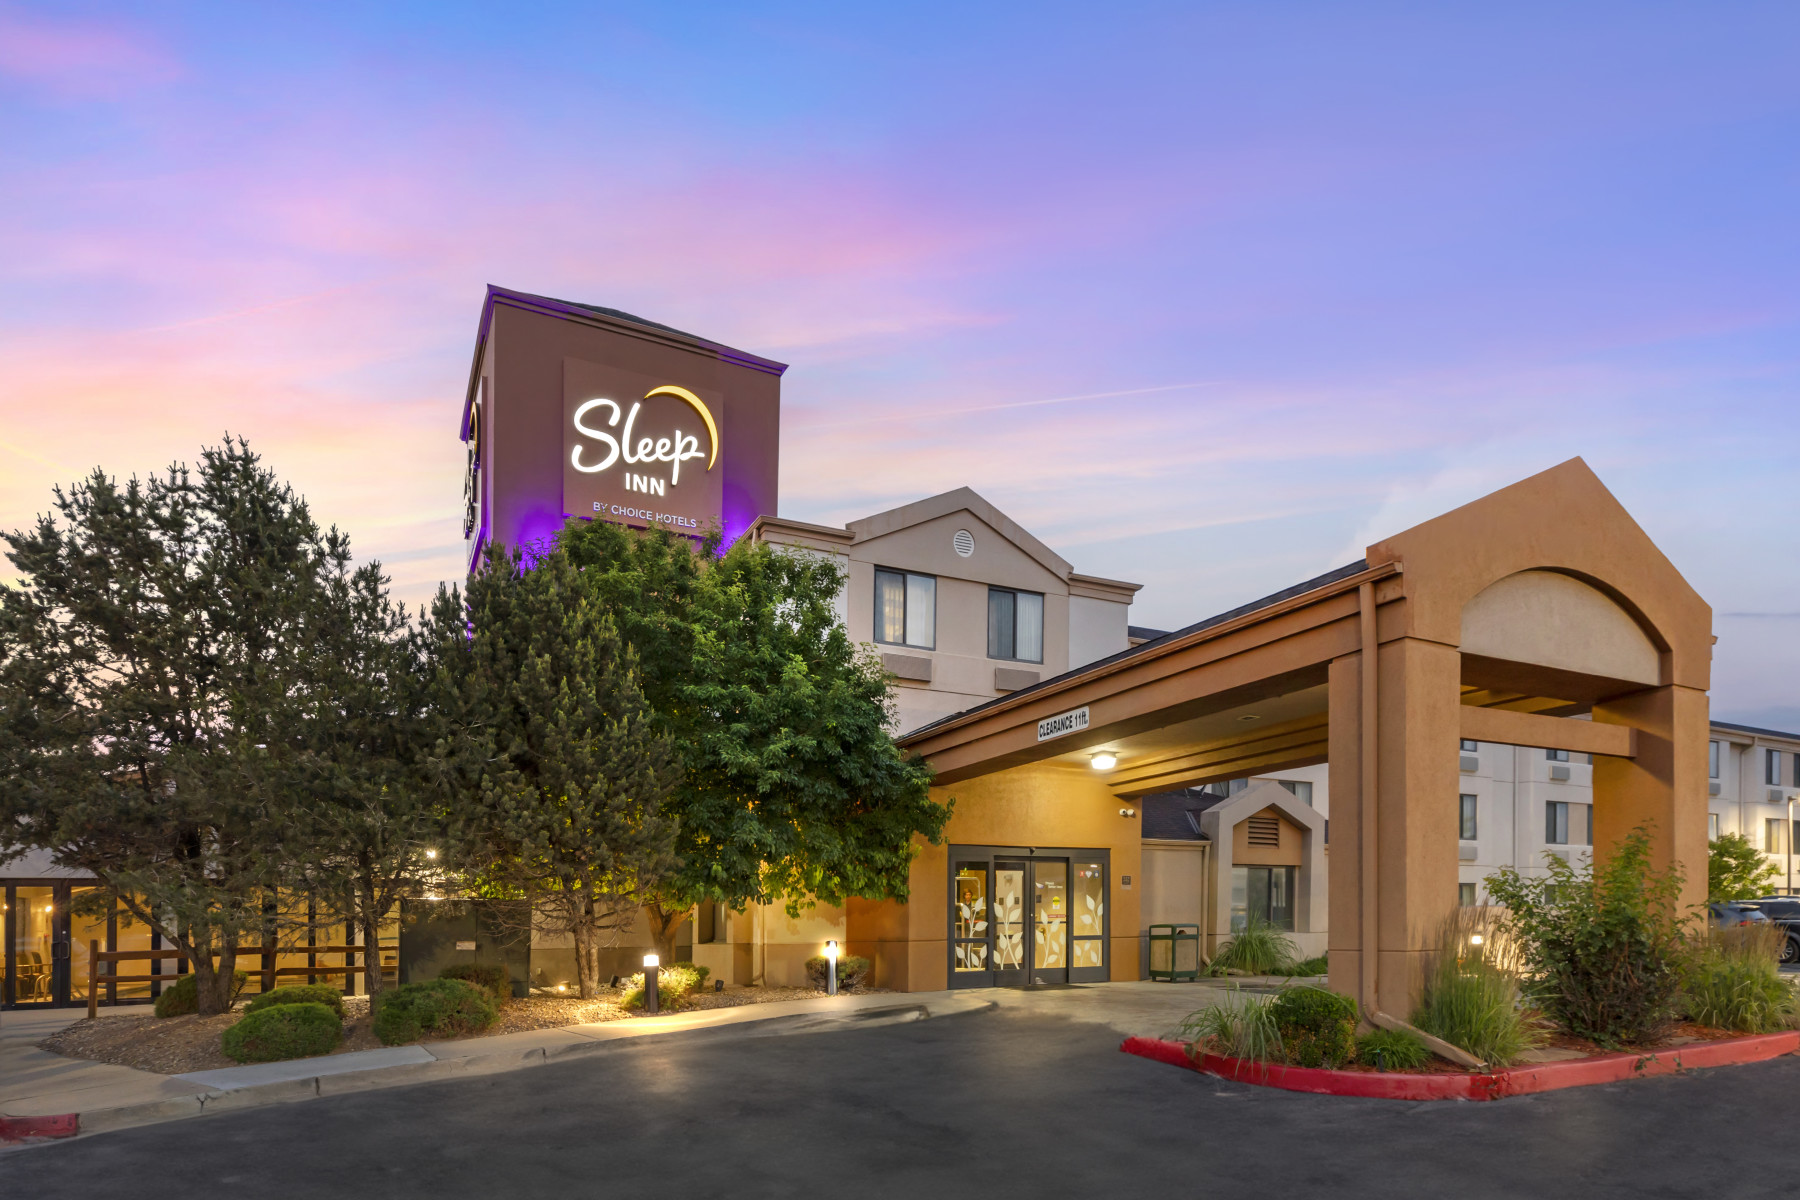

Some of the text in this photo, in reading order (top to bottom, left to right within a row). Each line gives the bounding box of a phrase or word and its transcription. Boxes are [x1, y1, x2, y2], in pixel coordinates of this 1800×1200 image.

[571, 398, 705, 486] Sleep
[625, 472, 664, 496] INN
[593, 502, 697, 528] BY CHOICE HOTELS
[1039, 715, 1073, 738] CLEARANCE
